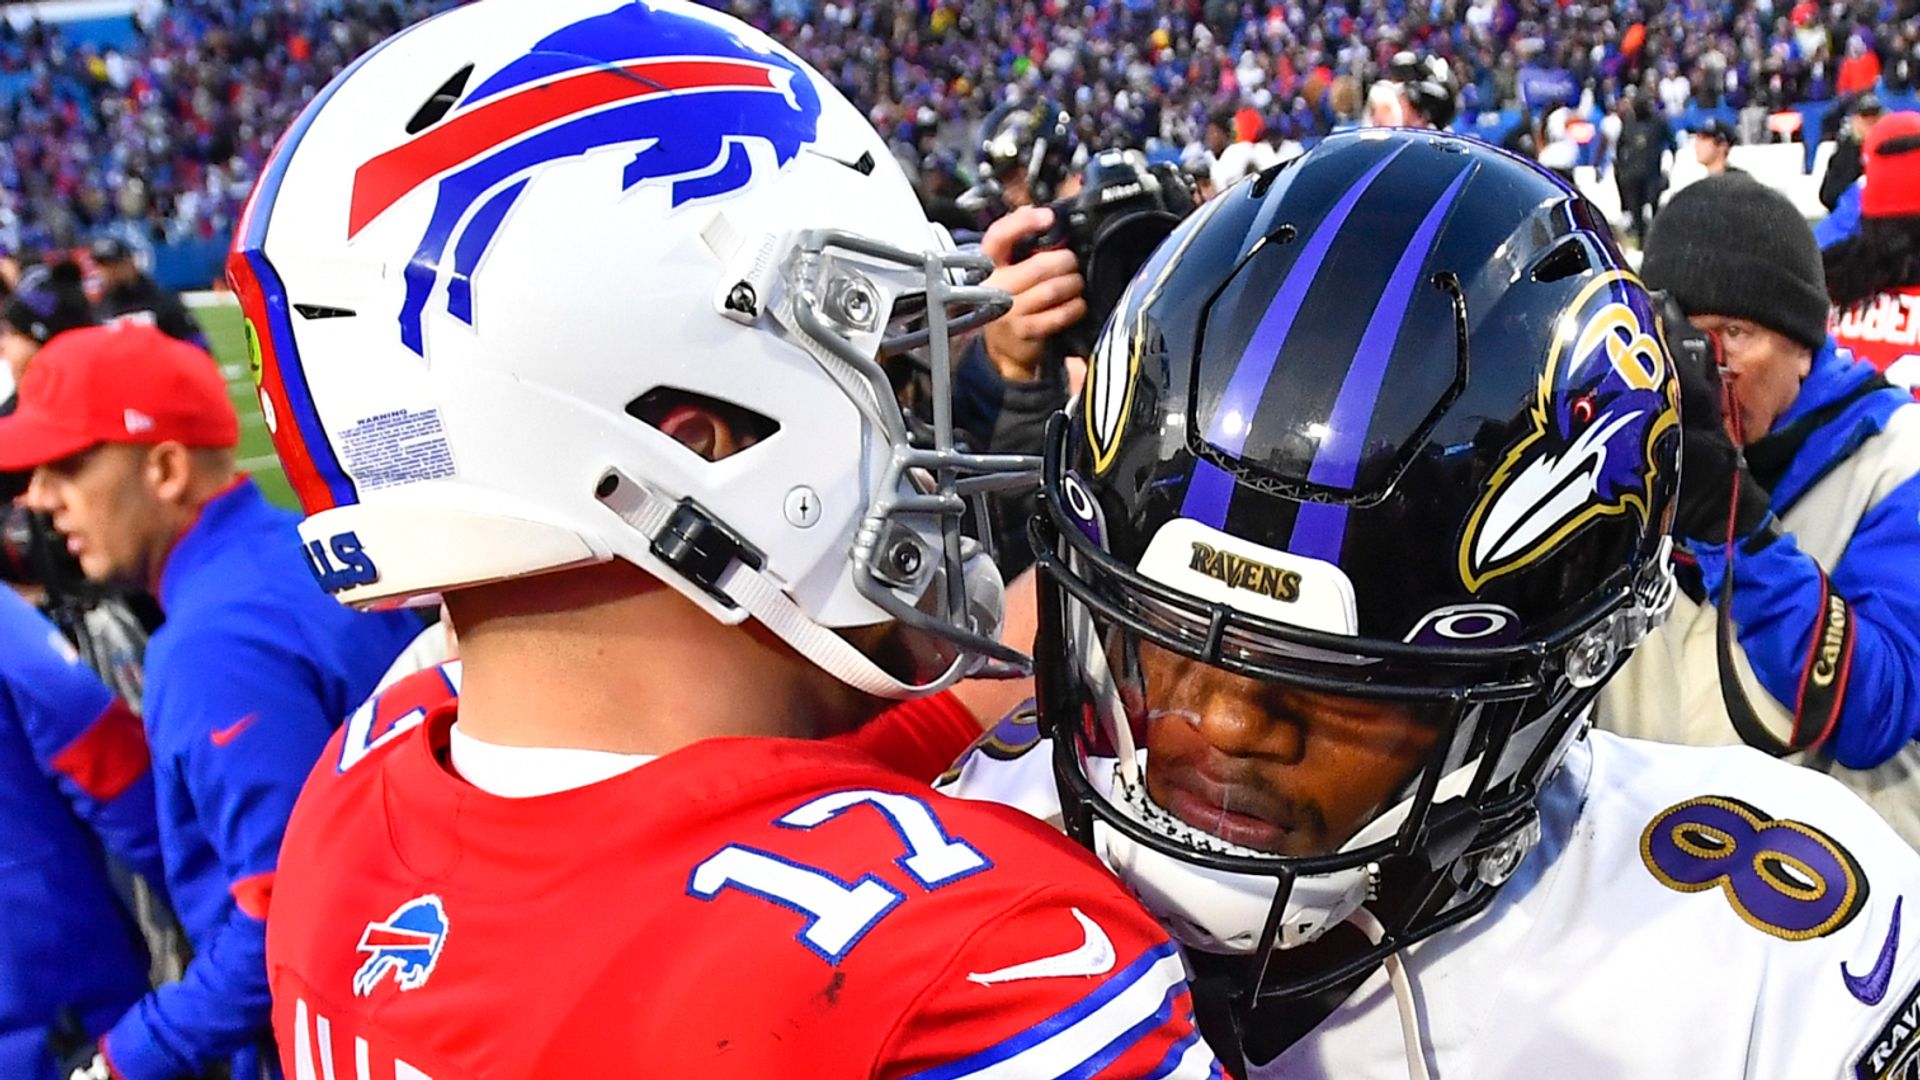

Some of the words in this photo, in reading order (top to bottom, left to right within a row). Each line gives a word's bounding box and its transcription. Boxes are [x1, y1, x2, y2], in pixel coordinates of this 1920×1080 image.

[357, 408, 408, 425] WARNING
[1188, 541, 1302, 603] RAVENS
[1813, 594, 1845, 686] Canon
[686, 789, 994, 967] 17
[1640, 795, 1870, 941] 8
[1866, 995, 1920, 1074] RAV
